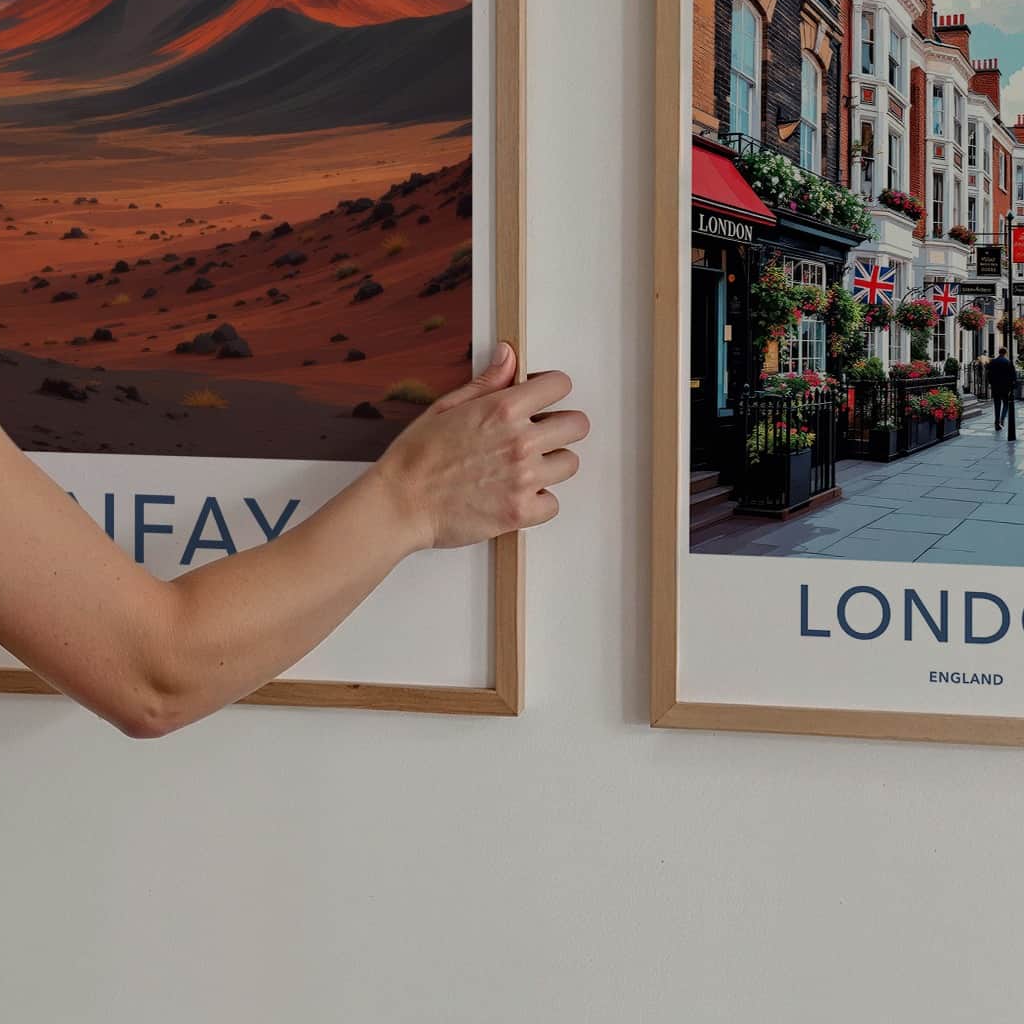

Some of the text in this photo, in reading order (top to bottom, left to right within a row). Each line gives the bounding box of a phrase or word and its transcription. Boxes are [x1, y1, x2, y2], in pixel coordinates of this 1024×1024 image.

[698, 213, 753, 242] LONDON
[800, 583, 1024, 645] LOND
[929, 670, 1004, 686] ENGLAND
